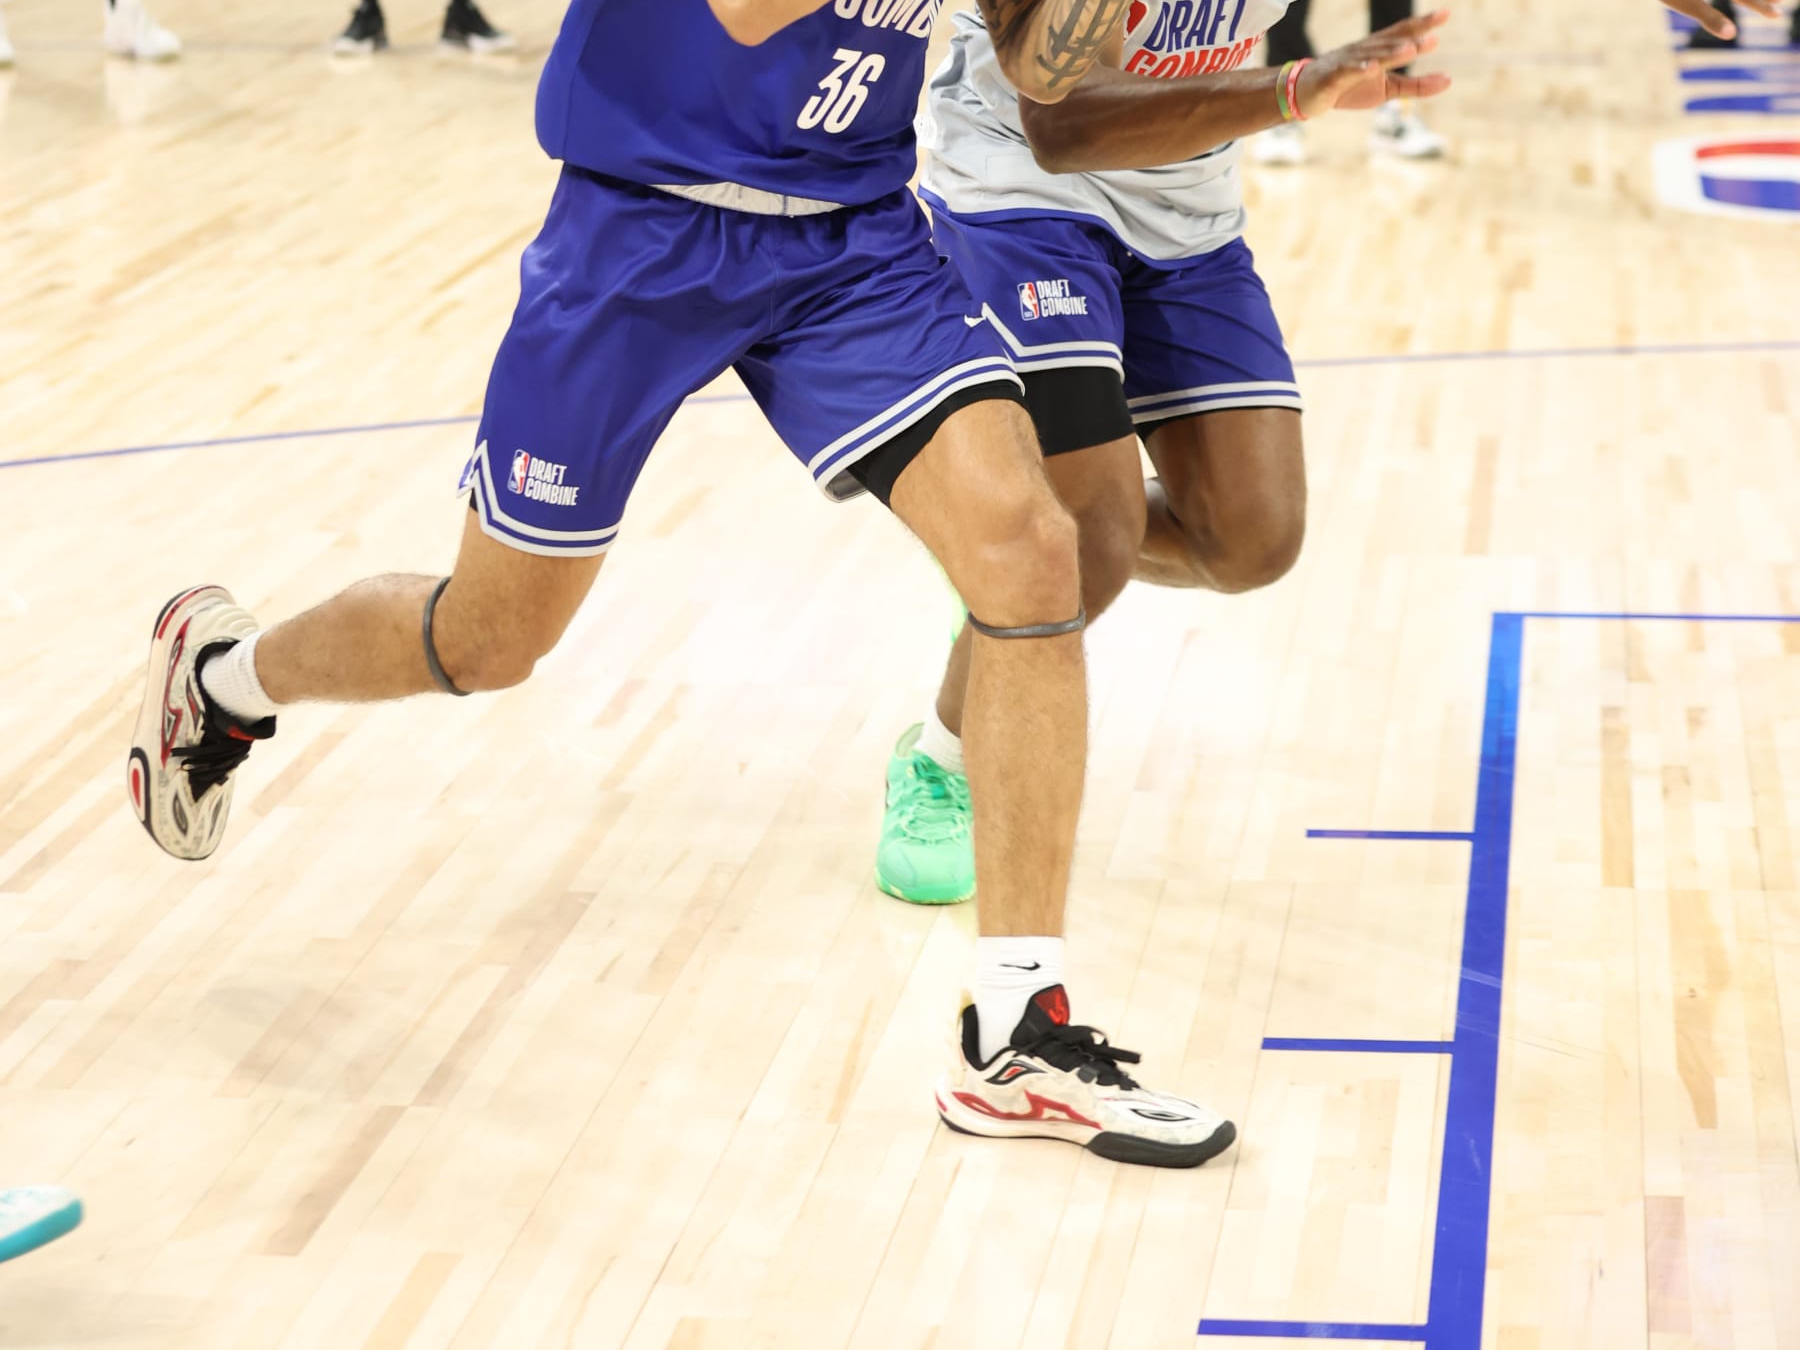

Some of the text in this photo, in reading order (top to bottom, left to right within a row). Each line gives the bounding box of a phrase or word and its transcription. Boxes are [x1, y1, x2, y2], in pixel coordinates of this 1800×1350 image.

[796, 47, 886, 134] 36
[1036, 280, 1070, 298] DRAFT
[1041, 297, 1087, 317] COMBINE
[528, 458, 567, 484] DRAFT
[525, 479, 579, 505] COMBINE
